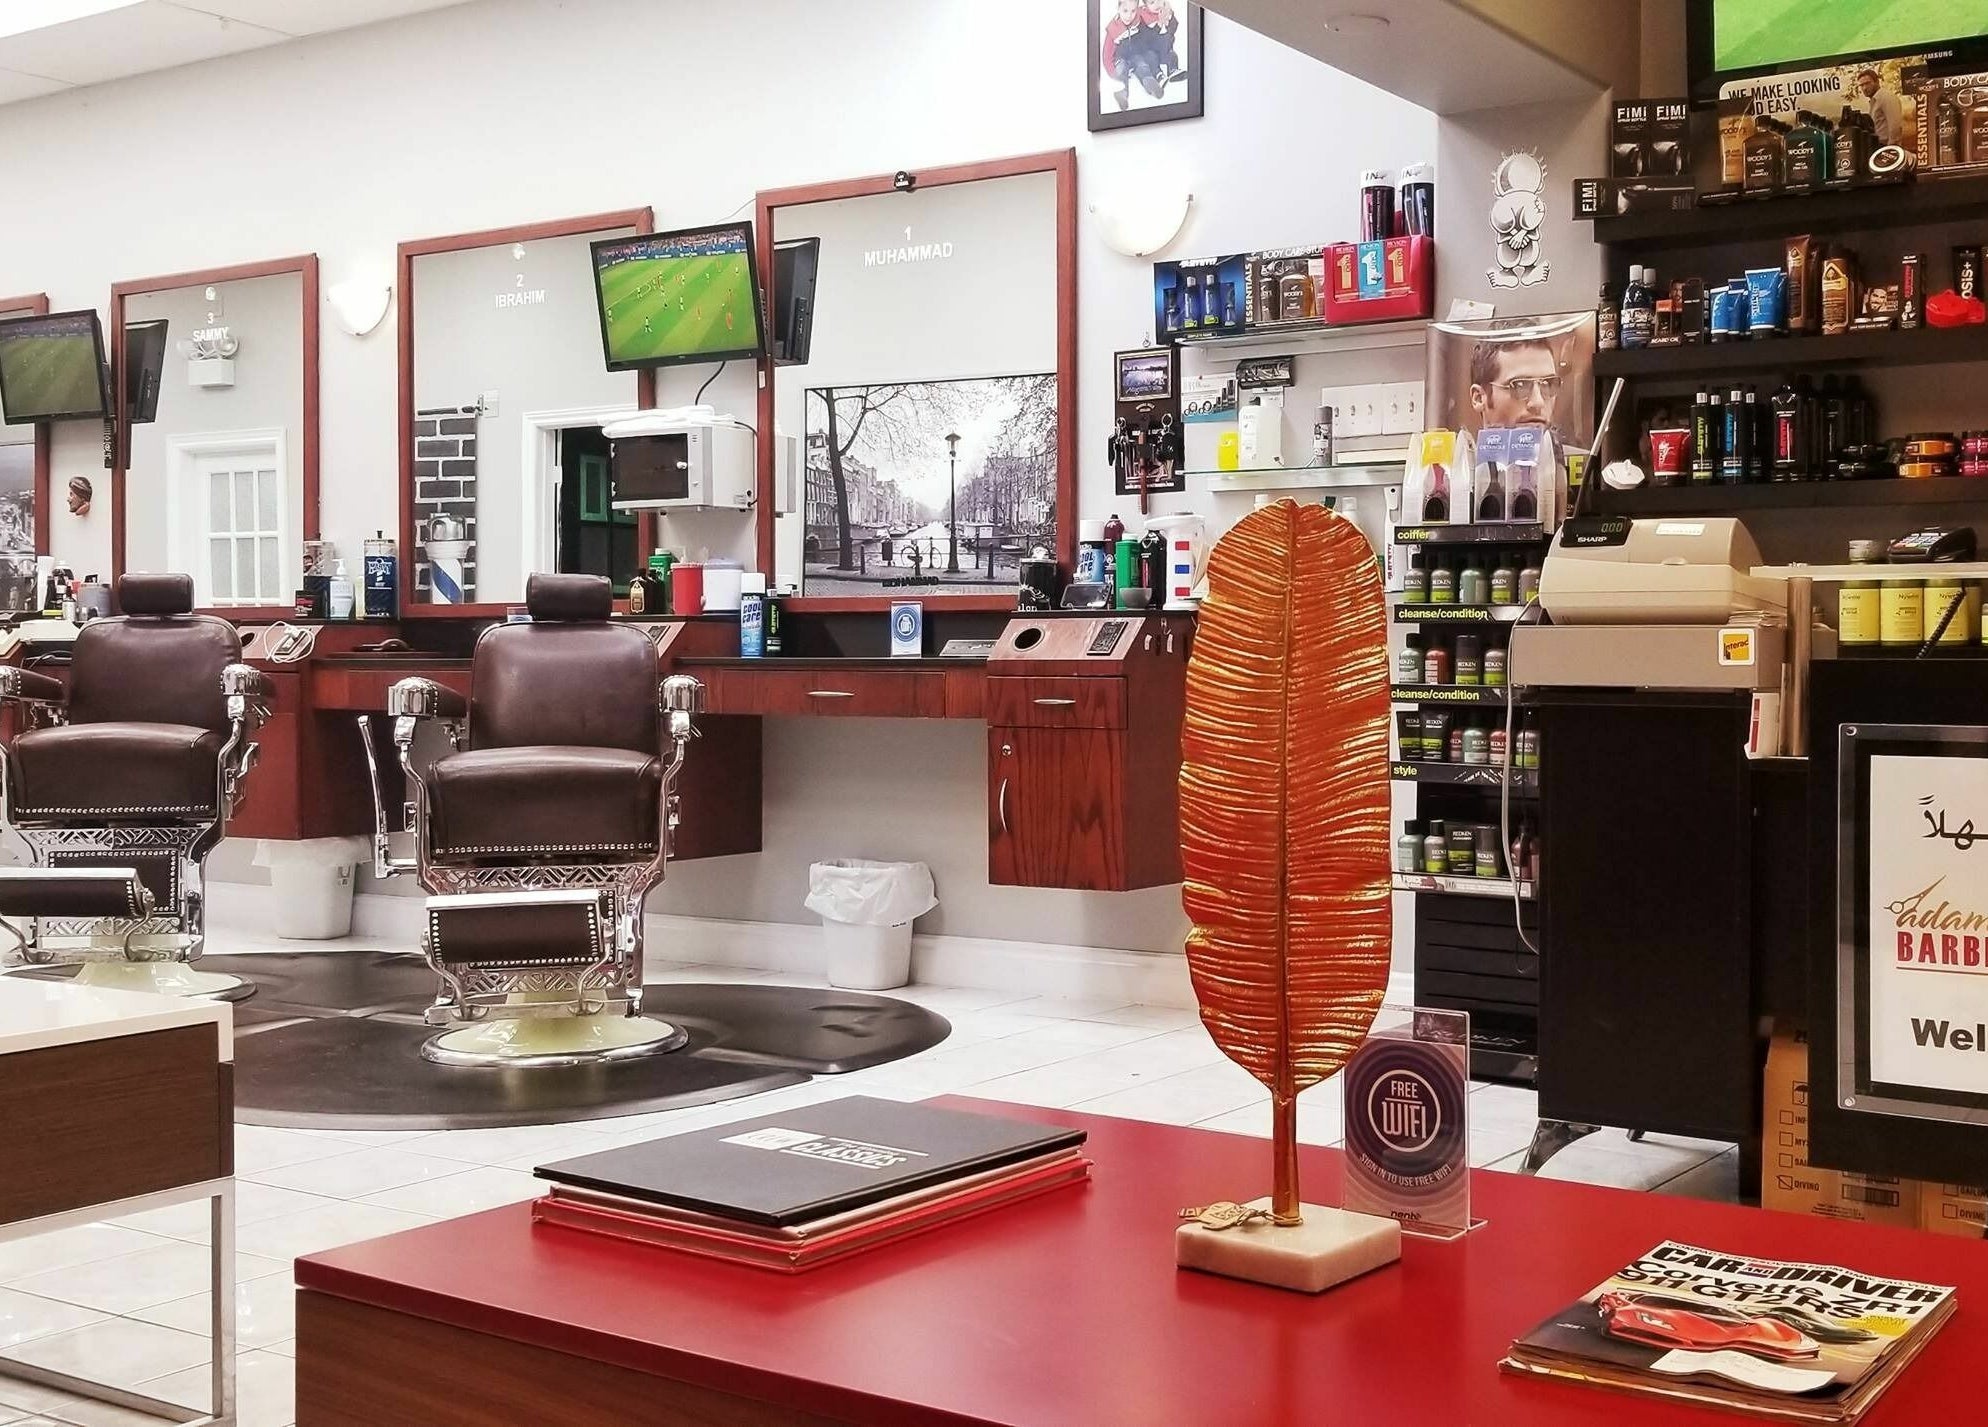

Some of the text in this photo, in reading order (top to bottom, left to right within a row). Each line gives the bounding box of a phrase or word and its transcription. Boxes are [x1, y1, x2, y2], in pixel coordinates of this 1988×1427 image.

[1751, 84, 1784, 100] MAKE
[1787, 76, 1840, 96] LOOKING
[1943, 75, 1974, 88] BODY
[1768, 97, 1801, 113] EASY.
[1917, 93, 1928, 166] ESSENTIALS
[904, 226, 911, 240] 1
[864, 242, 953, 267] MUHAMMAD
[1262, 249, 1283, 260] BODY
[516, 274, 524, 287] 2
[495, 290, 546, 309] IBRAHIM
[1244, 262, 1253, 322] ESSENTIALS
[207, 311, 214, 325] 3
[193, 327, 229, 342] SAMMY
[1397, 529, 1430, 541] coiffer
[1398, 608, 1488, 620] cleanse/condition
[1391, 689, 1480, 700] cleanse/condition
[1394, 766, 1418, 777] style
[1391, 1080, 1418, 1099] FREE
[1381, 1101, 1427, 1140] WIFI
[791, 1142, 908, 1167] CLASSICS
[1359, 1153, 1452, 1188] SIGN IN TO USE FREE WIFI
[1794, 1182, 1820, 1192] DIVING
[1651, 1247, 1943, 1303] CAR AND DRIVER
[1617, 1268, 1865, 1319] 911 GT2 RS
[1631, 1261, 1924, 1315] Corvette ZR1
